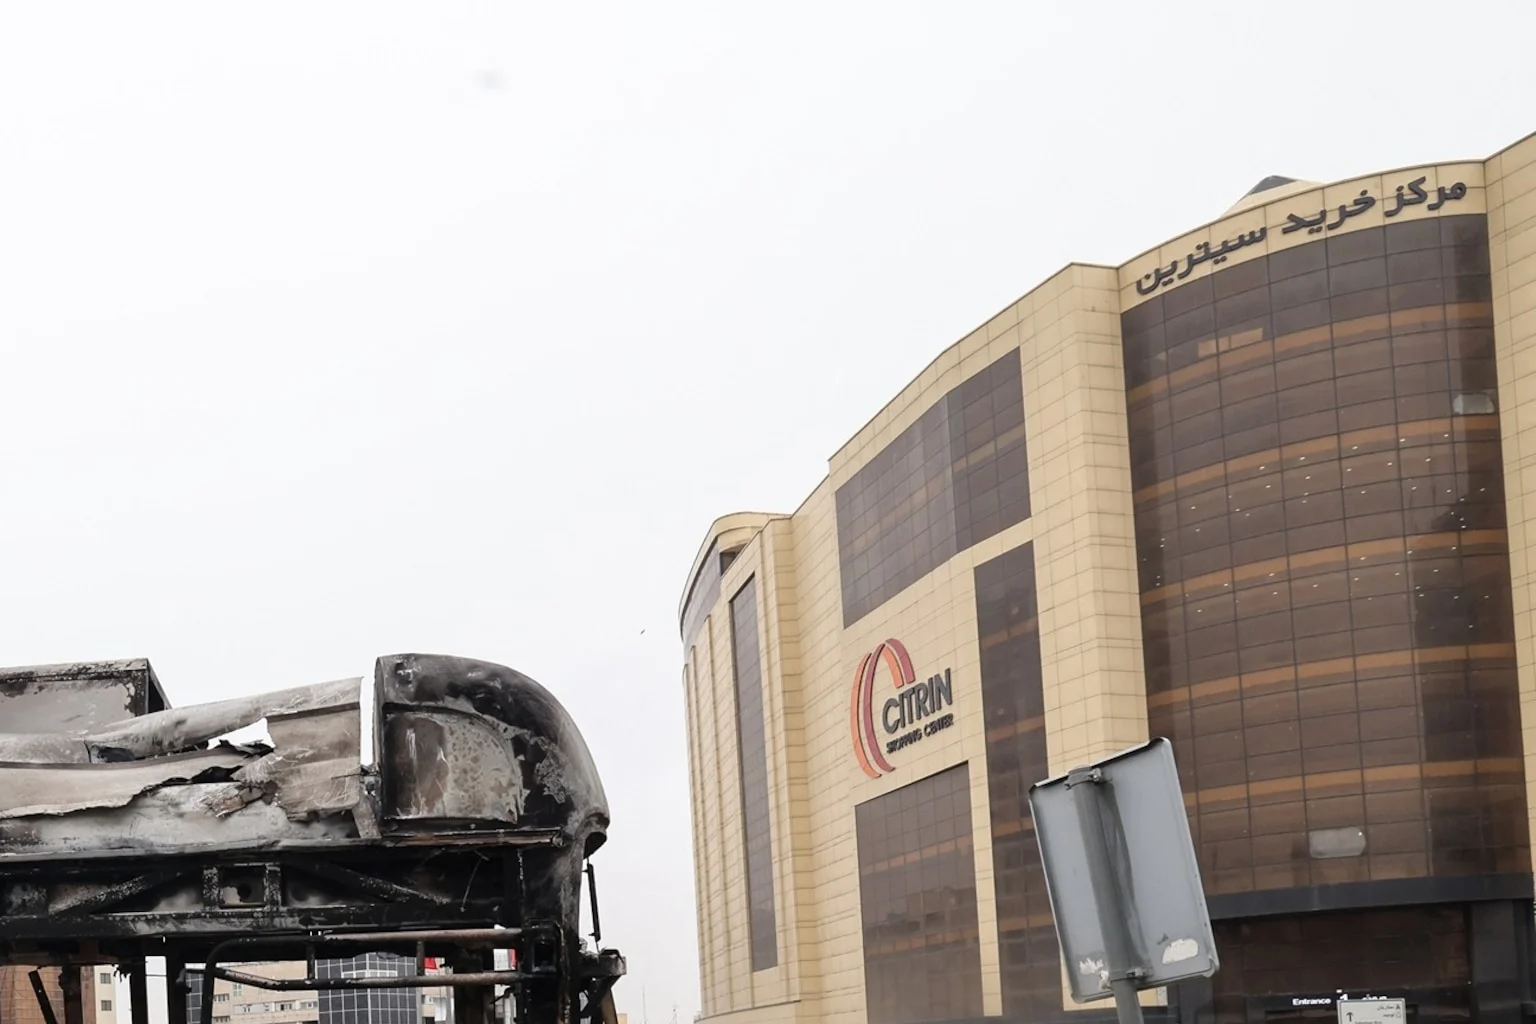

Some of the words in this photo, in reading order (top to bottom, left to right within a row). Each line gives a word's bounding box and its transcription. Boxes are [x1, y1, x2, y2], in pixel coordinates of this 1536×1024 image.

[1281, 188, 1377, 235] خرید
[1385, 176, 1467, 218] مرکز
[1135, 227, 1268, 295] سیترین
[882, 667, 953, 734] CITRIN
[1292, 998, 1331, 1006] Entrance
